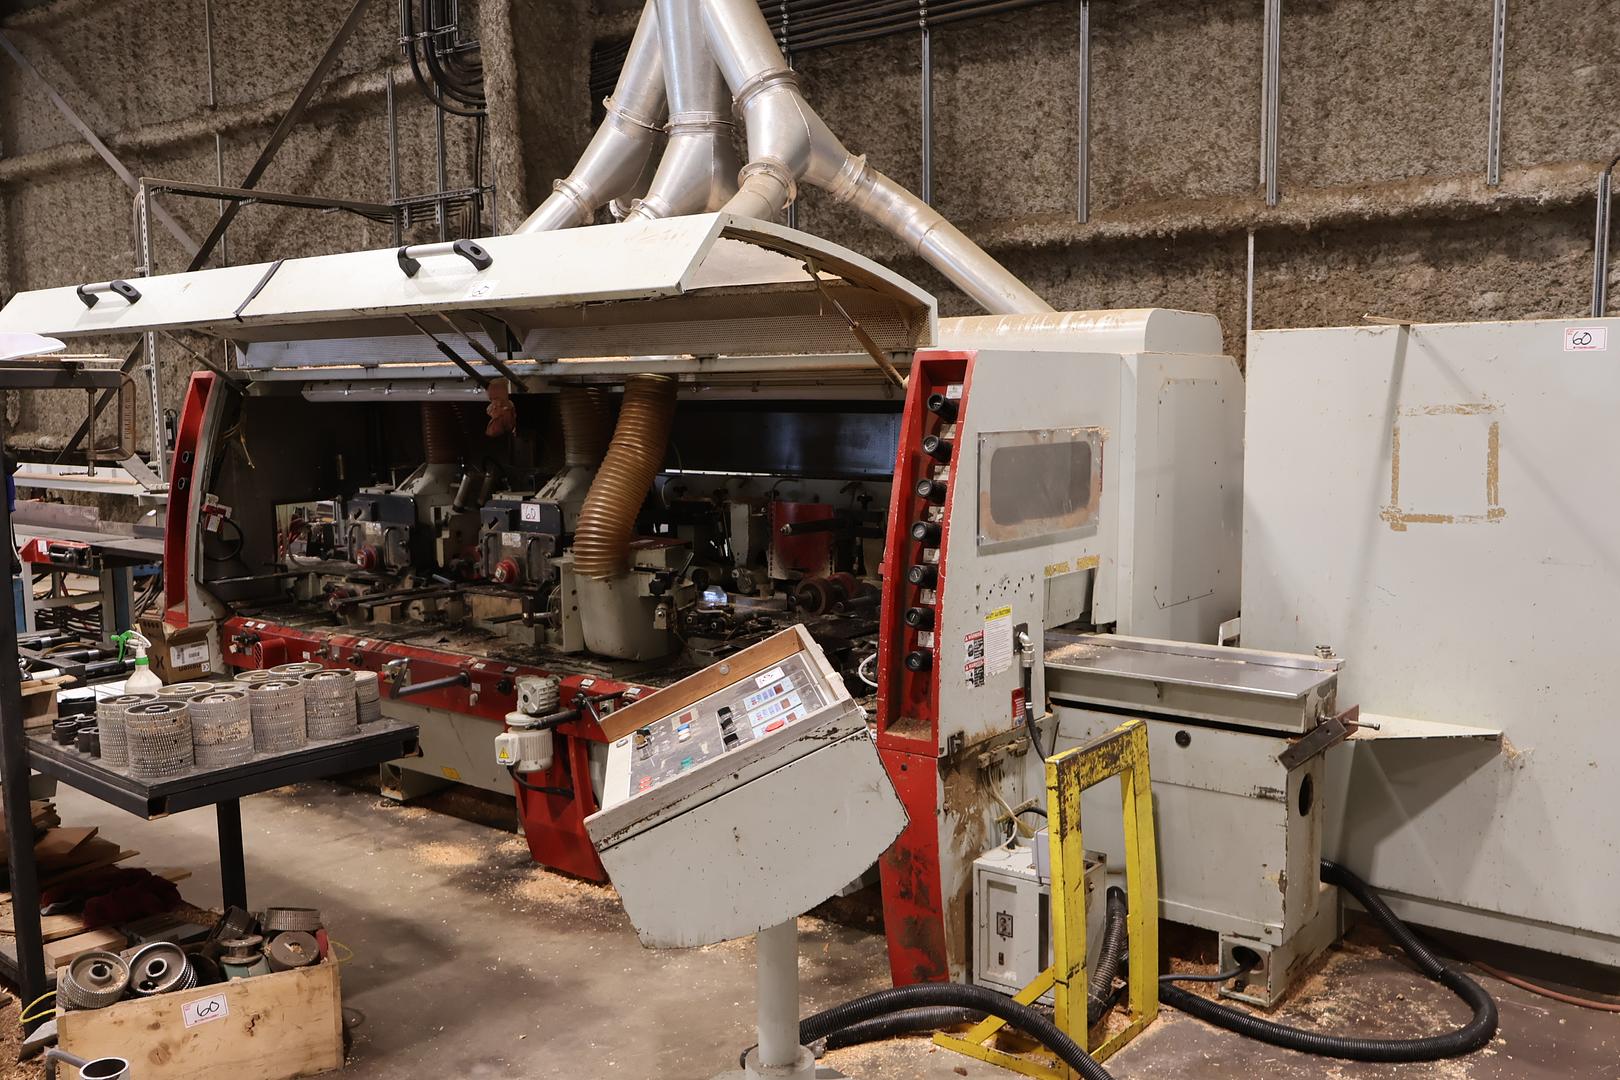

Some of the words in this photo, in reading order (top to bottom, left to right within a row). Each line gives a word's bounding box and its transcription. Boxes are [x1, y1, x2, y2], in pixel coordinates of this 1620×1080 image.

[1572, 331, 1592, 345] 60
[525, 505, 537, 519] 60
[197, 1001, 219, 1017] 60
